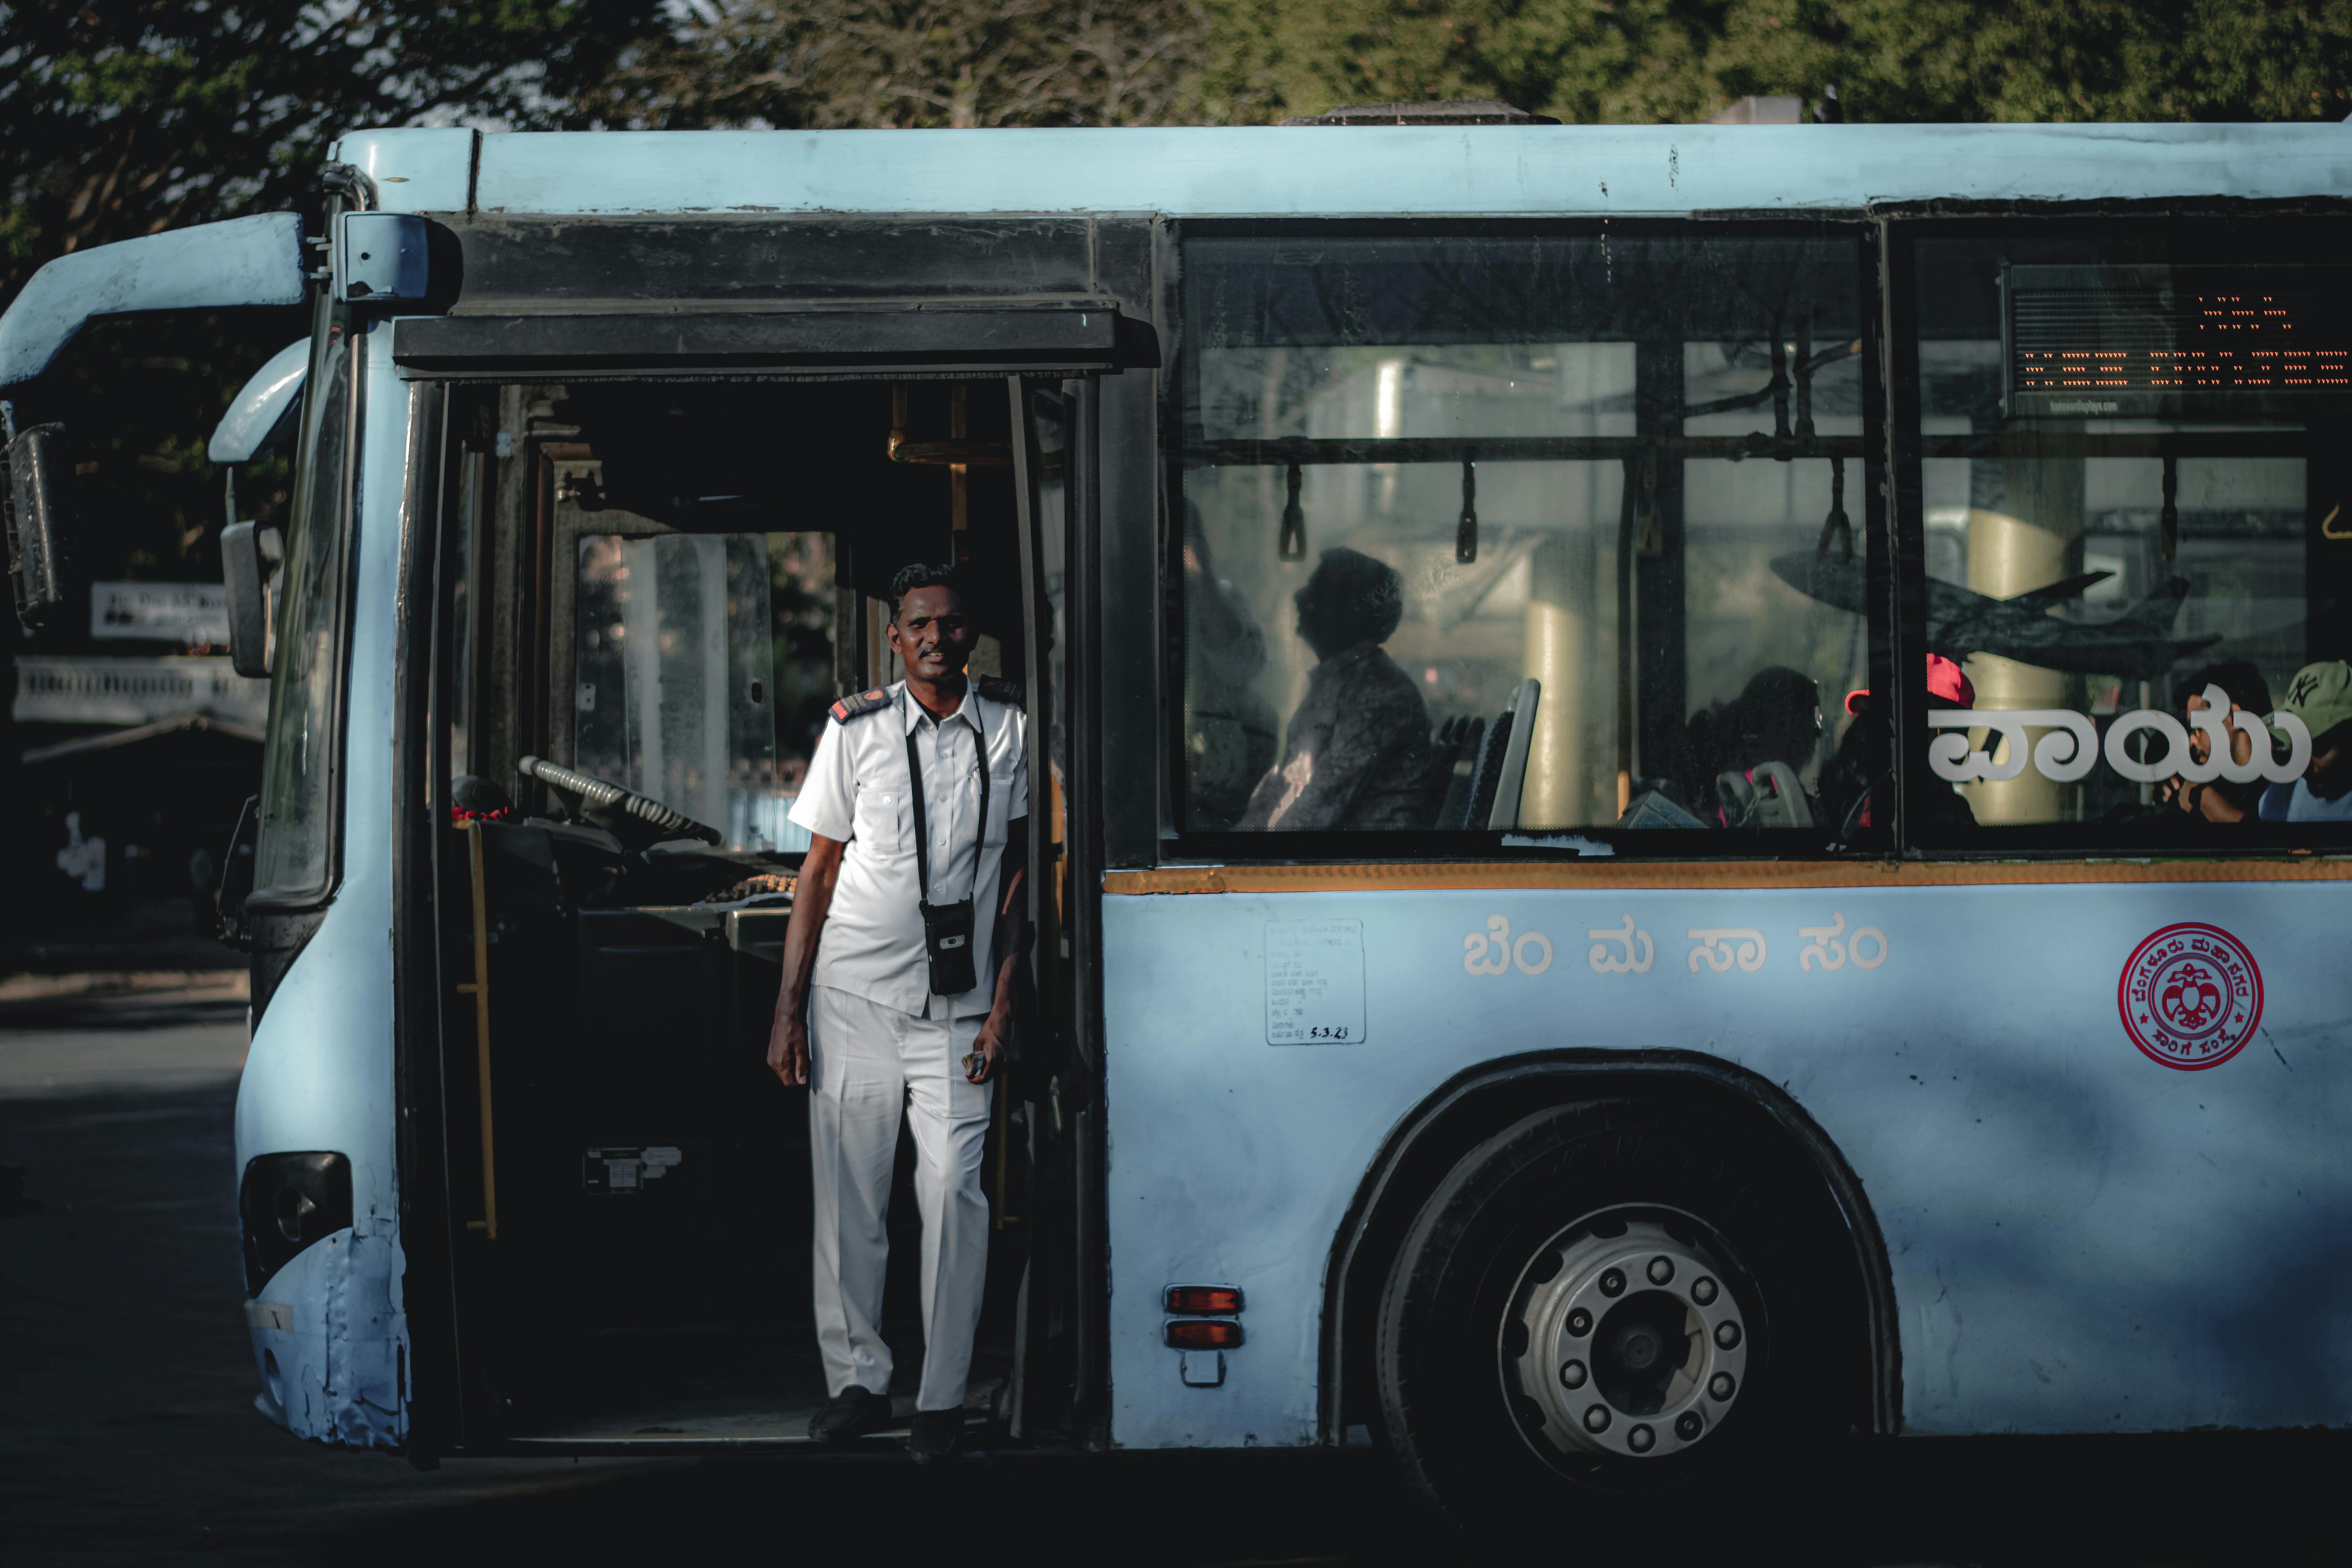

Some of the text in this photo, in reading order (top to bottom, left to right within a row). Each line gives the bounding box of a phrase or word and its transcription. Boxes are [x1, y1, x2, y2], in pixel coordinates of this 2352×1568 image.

[1928, 683, 2312, 783] ವಾಯು
[1463, 909, 1889, 976] ಬೆಂ ಮ ಸಾ ಸಂ
[1310, 1026, 1348, 1040] 5.3.23
